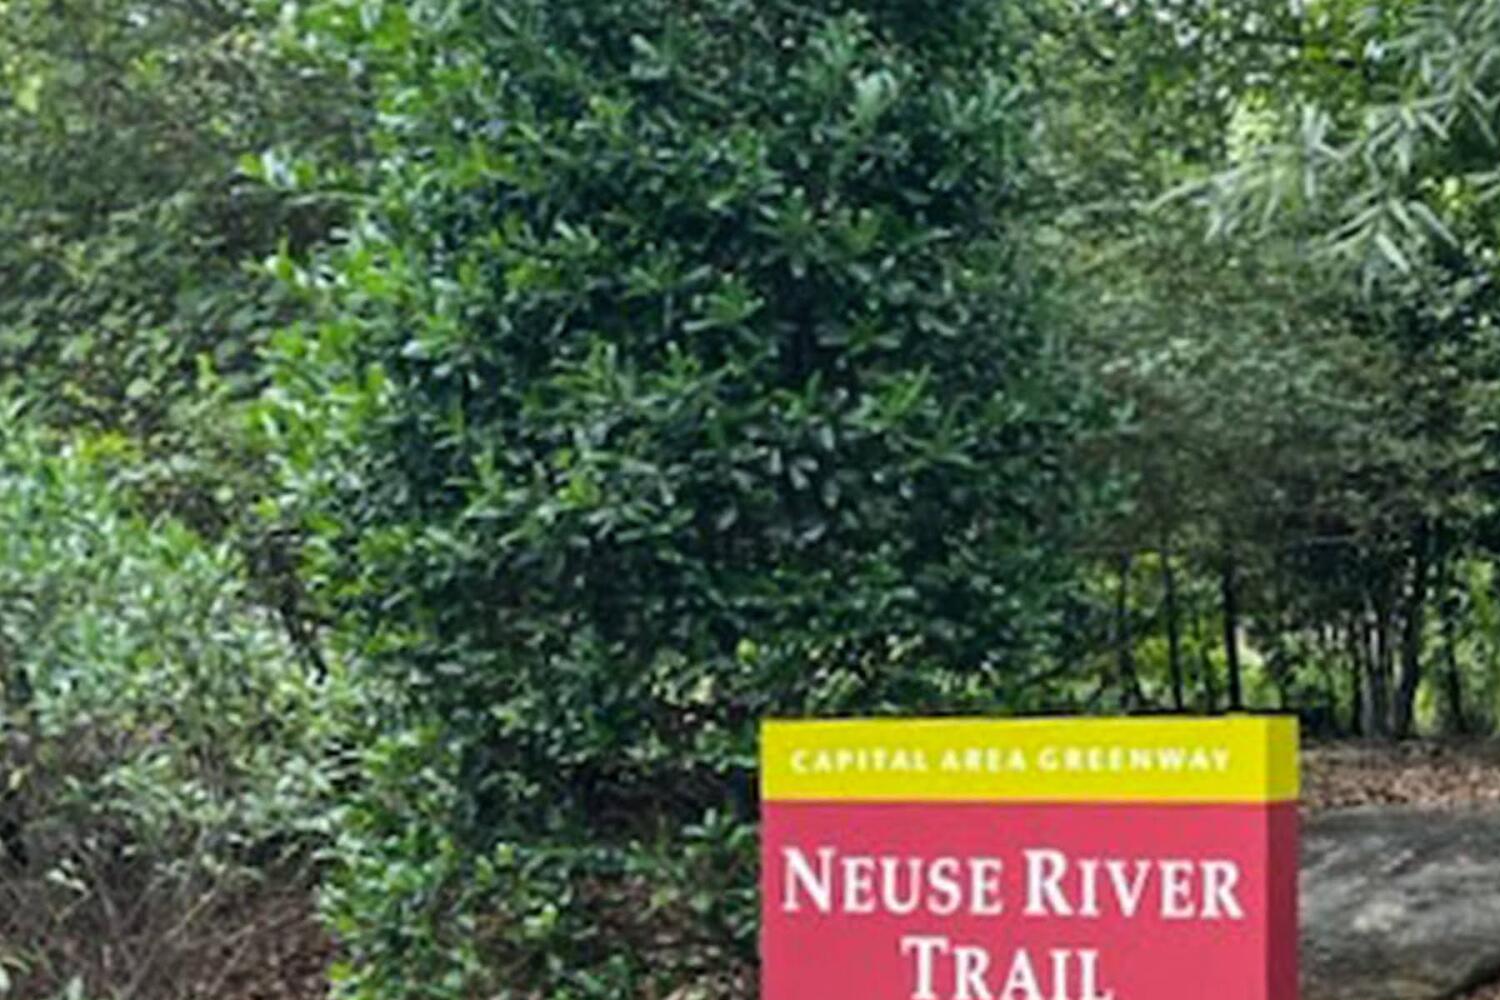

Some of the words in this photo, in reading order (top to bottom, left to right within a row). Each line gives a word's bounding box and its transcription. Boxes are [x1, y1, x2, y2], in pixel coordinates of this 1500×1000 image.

[791, 747, 927, 773] CAPITAL
[941, 748, 1026, 772] AREA
[1037, 747, 1230, 772] GREENWAY
[782, 847, 1003, 914] NEUSE
[1023, 849, 1244, 920] RIVER
